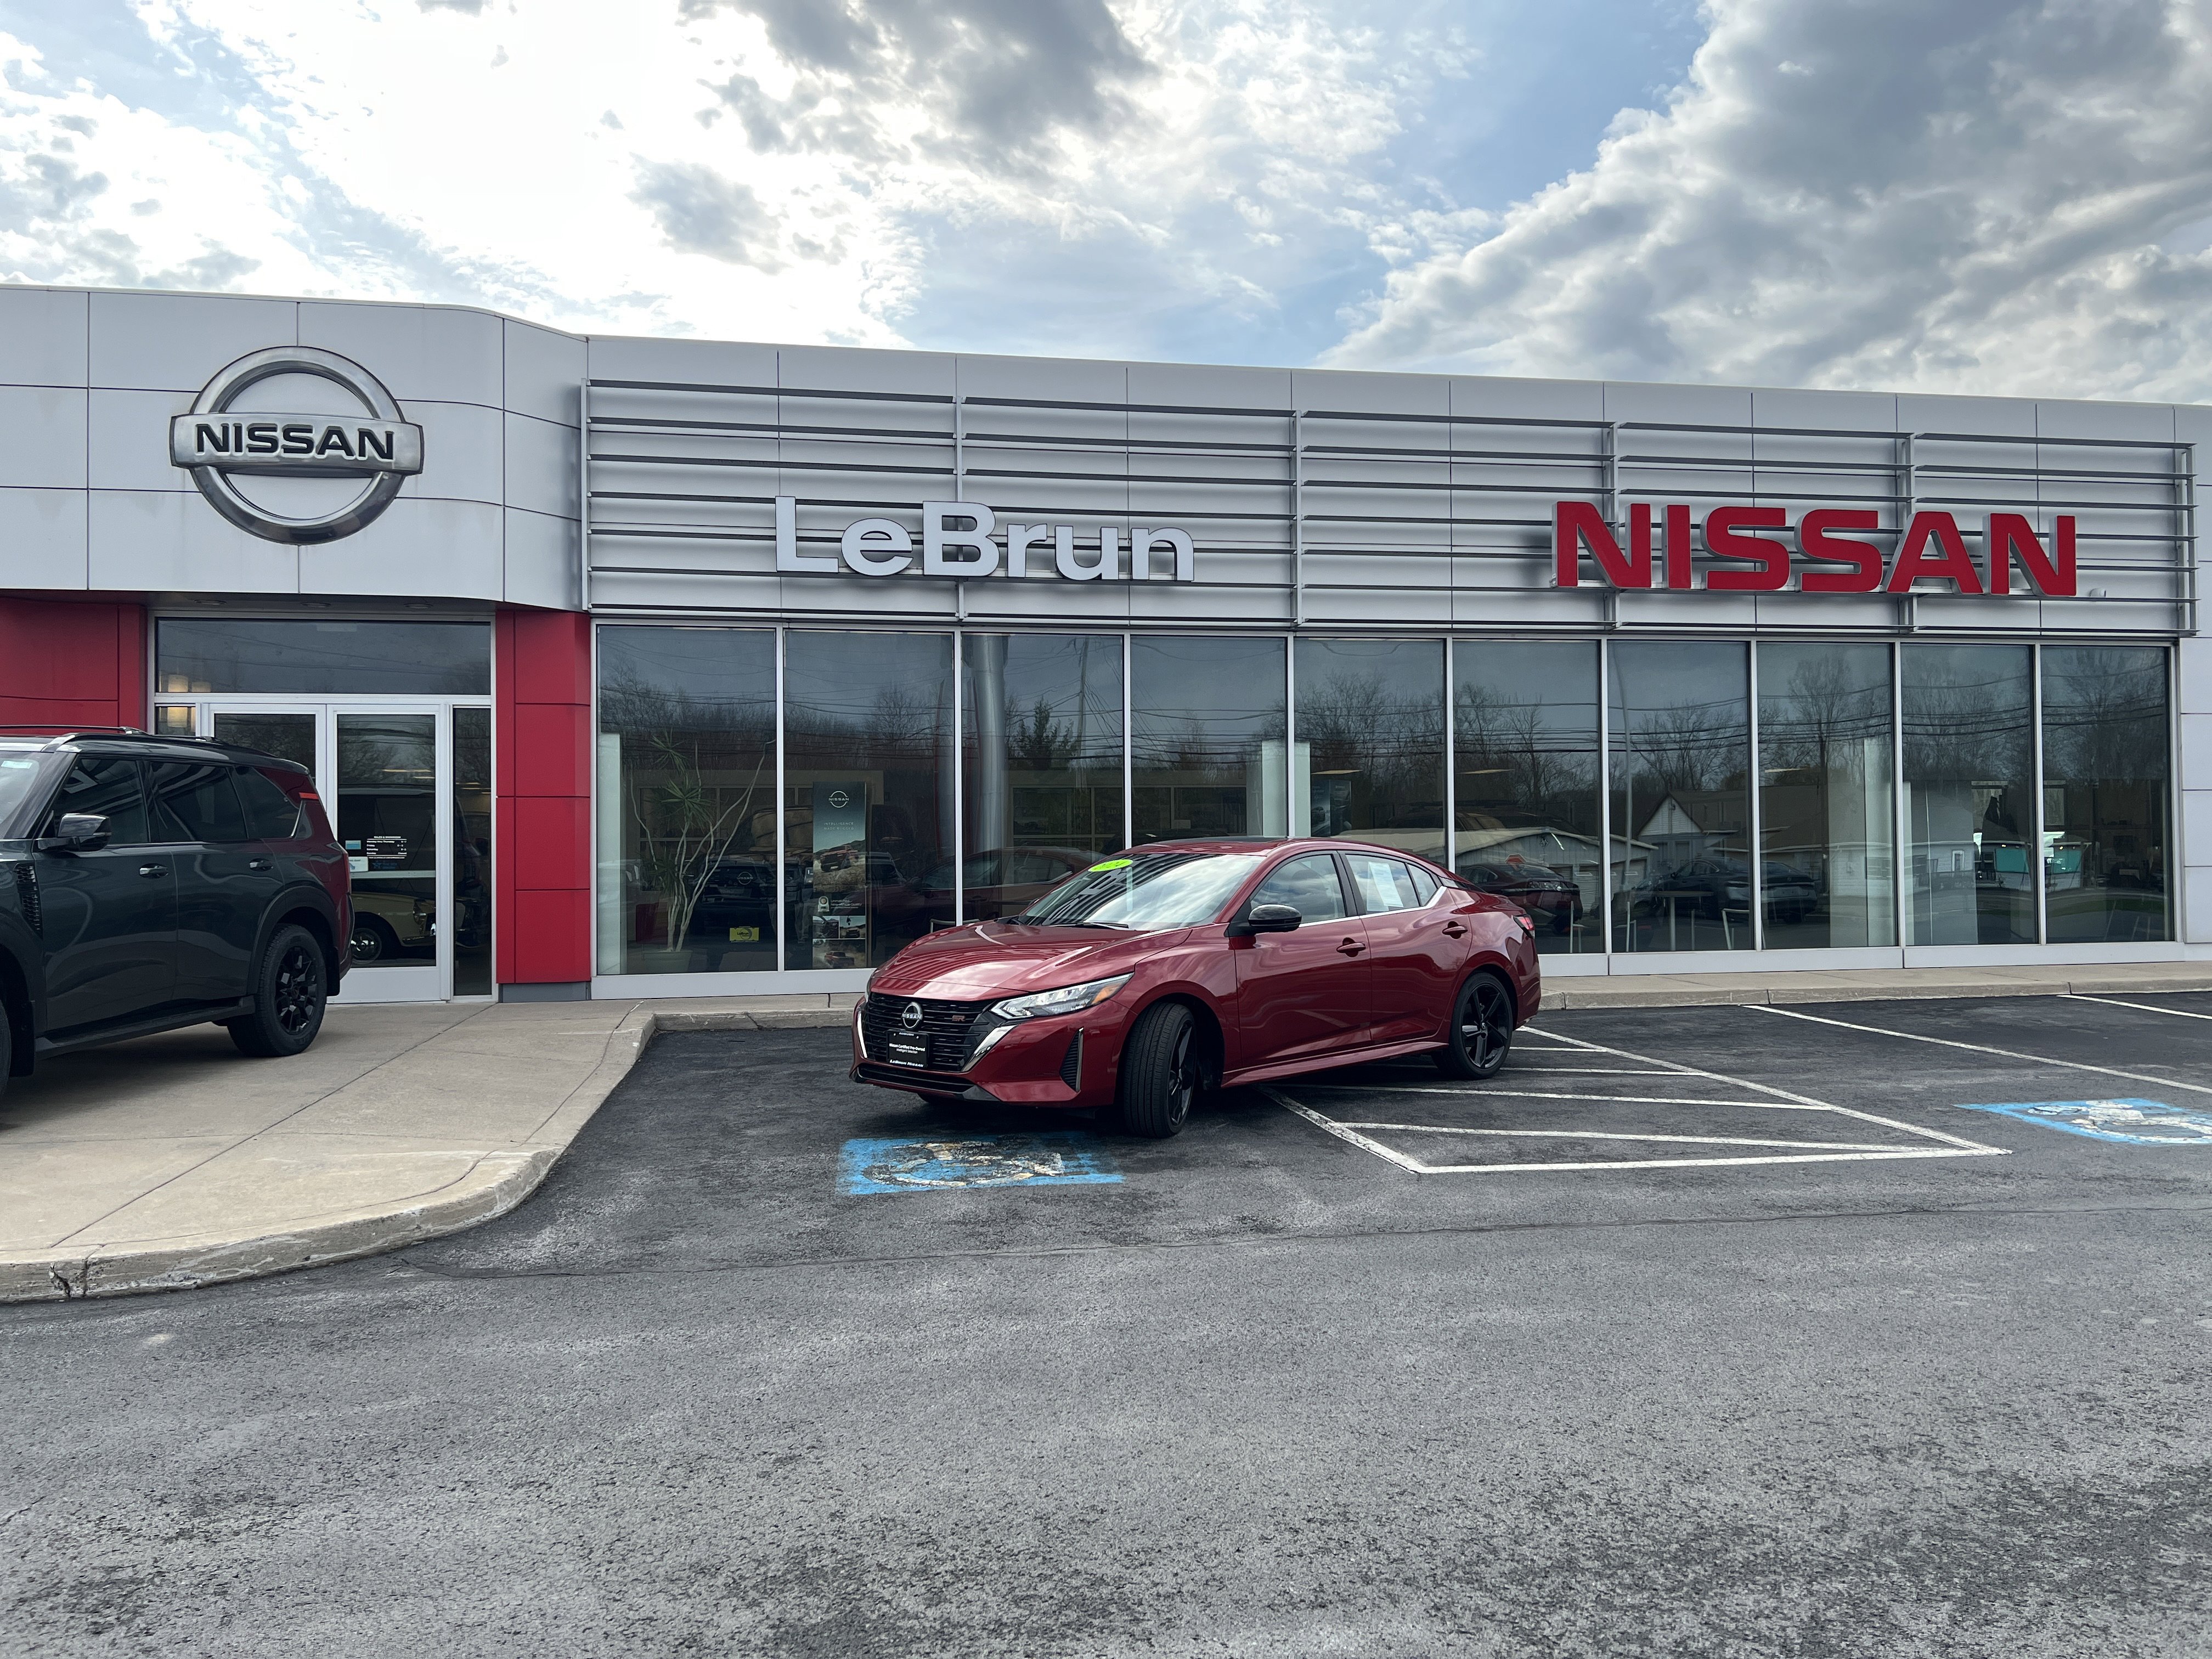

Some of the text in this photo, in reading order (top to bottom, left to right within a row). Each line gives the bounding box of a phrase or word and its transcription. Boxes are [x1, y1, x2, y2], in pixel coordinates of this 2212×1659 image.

[195, 423, 395, 461] NISSAN
[775, 495, 1195, 582] LeBrun
[1553, 501, 2077, 597] NISSAN
